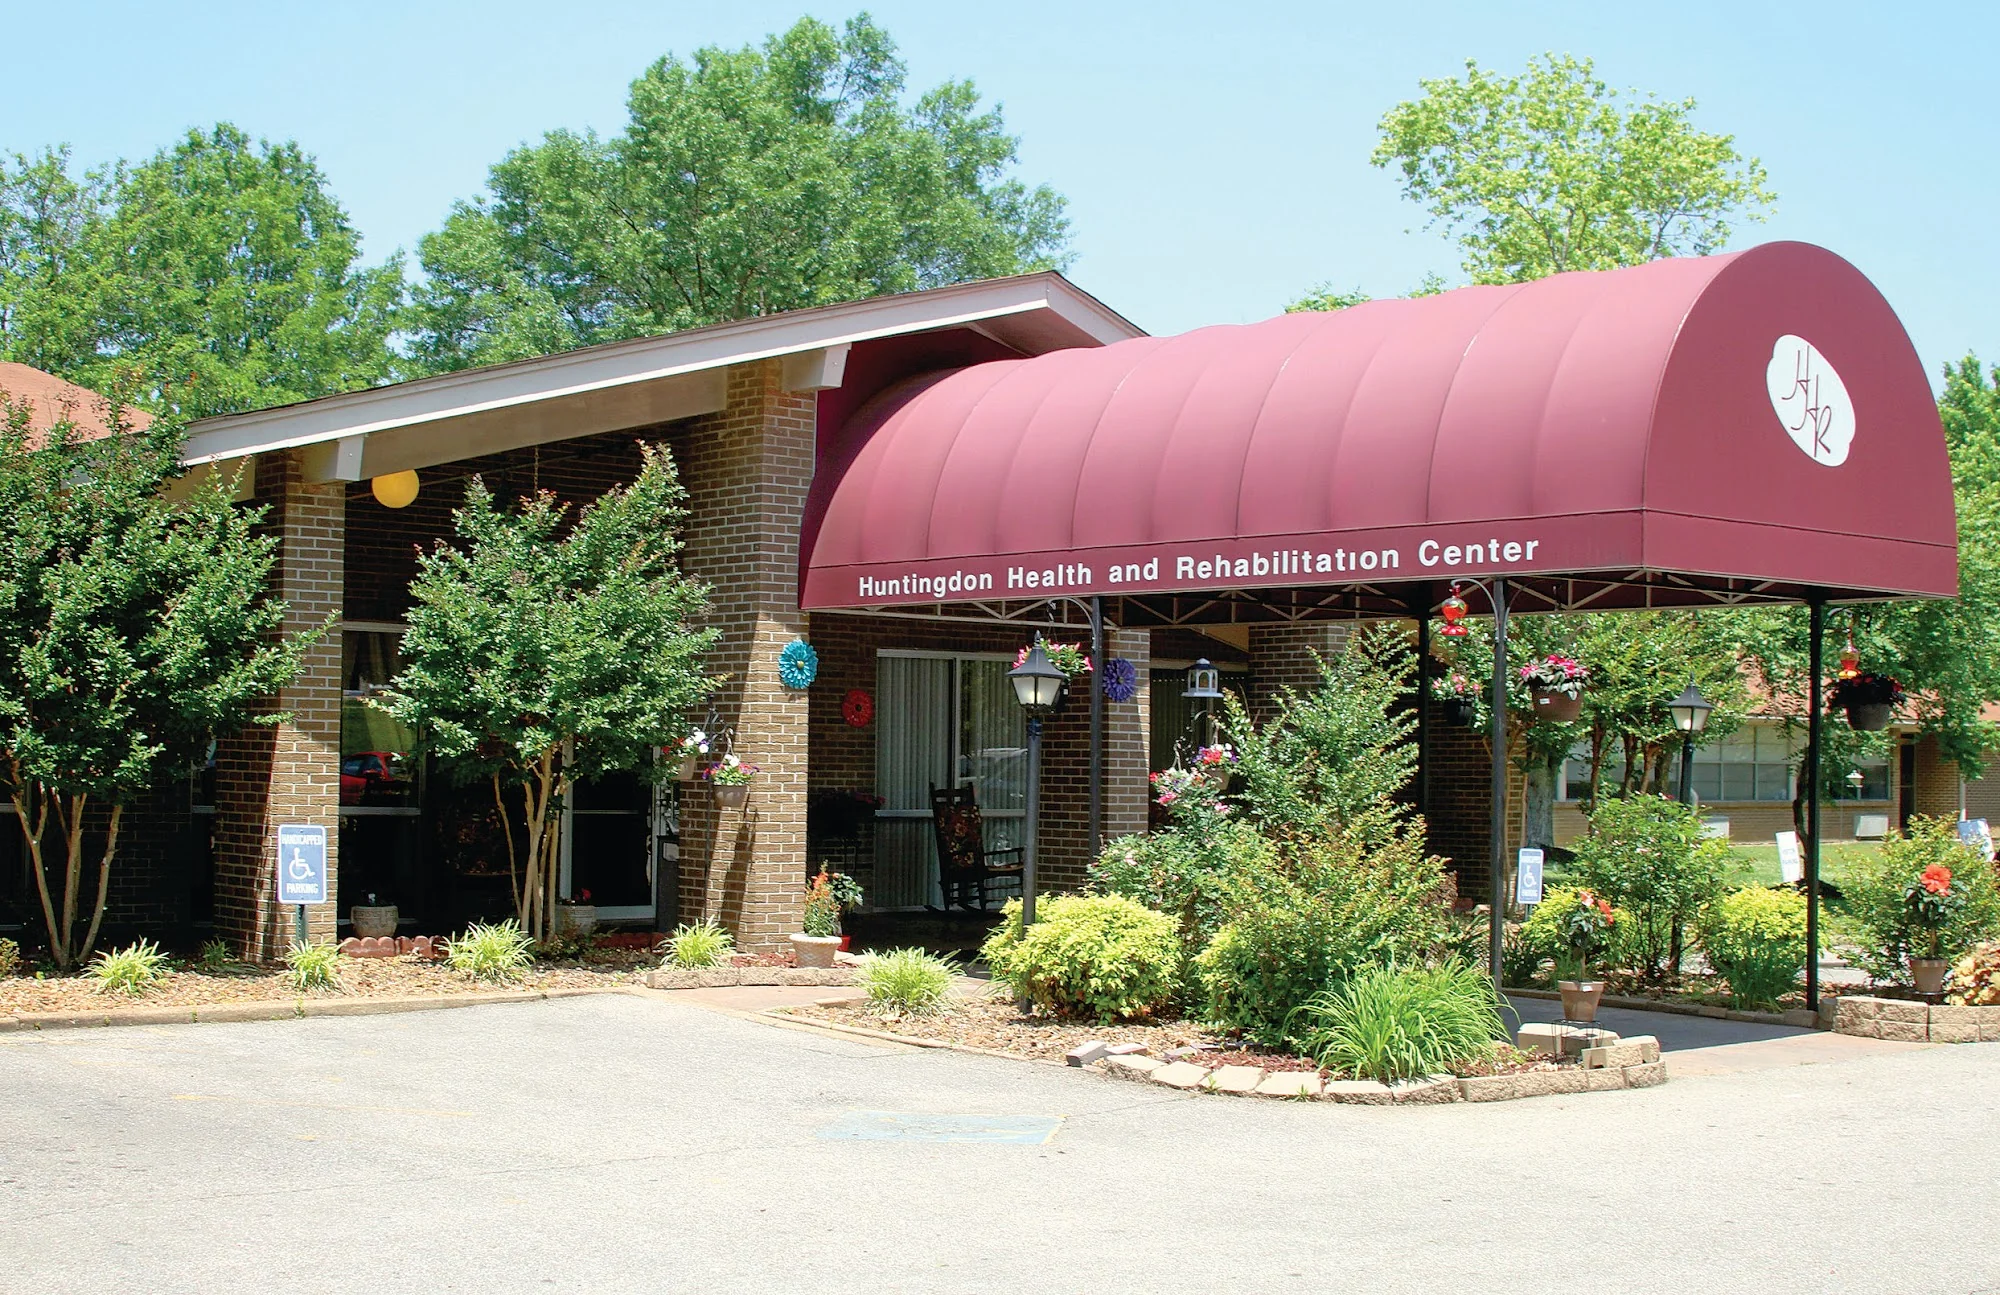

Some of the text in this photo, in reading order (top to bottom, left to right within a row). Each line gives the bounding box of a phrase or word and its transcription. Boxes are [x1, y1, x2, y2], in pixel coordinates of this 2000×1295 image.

[859, 539, 1540, 598] Huntingdon Health and Rehabilitation Center
[286, 883, 319, 895] PARKING
